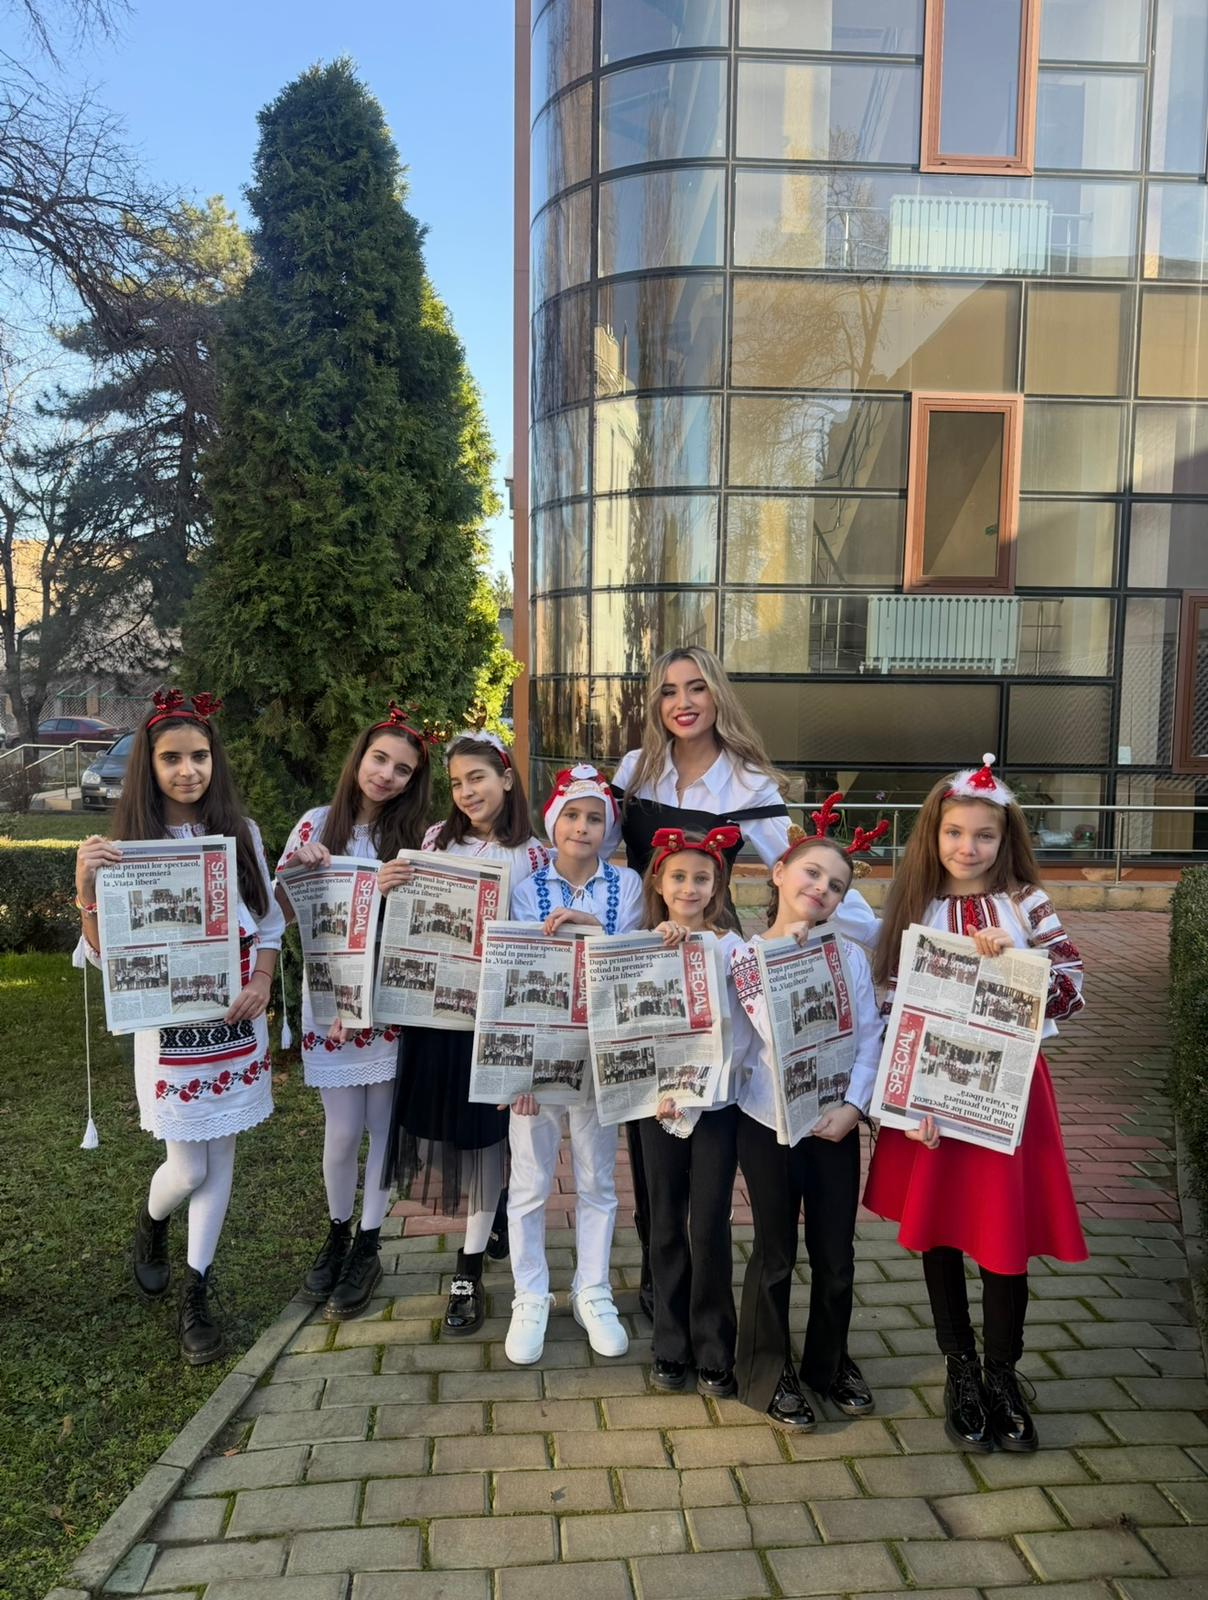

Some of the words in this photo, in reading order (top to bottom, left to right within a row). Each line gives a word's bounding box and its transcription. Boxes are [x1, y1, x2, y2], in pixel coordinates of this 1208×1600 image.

[123, 863, 150, 871] primul
[137, 870, 171, 878] premieră
[211, 862, 225, 921] SPECIAL
[354, 880, 373, 935] SPECIAL
[505, 943, 528, 951] primul
[517, 951, 546, 959] premieră
[609, 956, 633, 965] primul
[590, 966, 611, 974] colind
[622, 962, 653, 972] premieră
[690, 951, 707, 1015] SPECIAL
[888, 1029, 916, 1094] SPECIAL
[944, 1095, 980, 1109] premieră
[951, 1106, 962, 1114] lor
[992, 1107, 1016, 1120] colind
[1012, 1104, 1019, 1112] la
[963, 1109, 992, 1122] primul
[994, 1118, 1014, 1129] După
